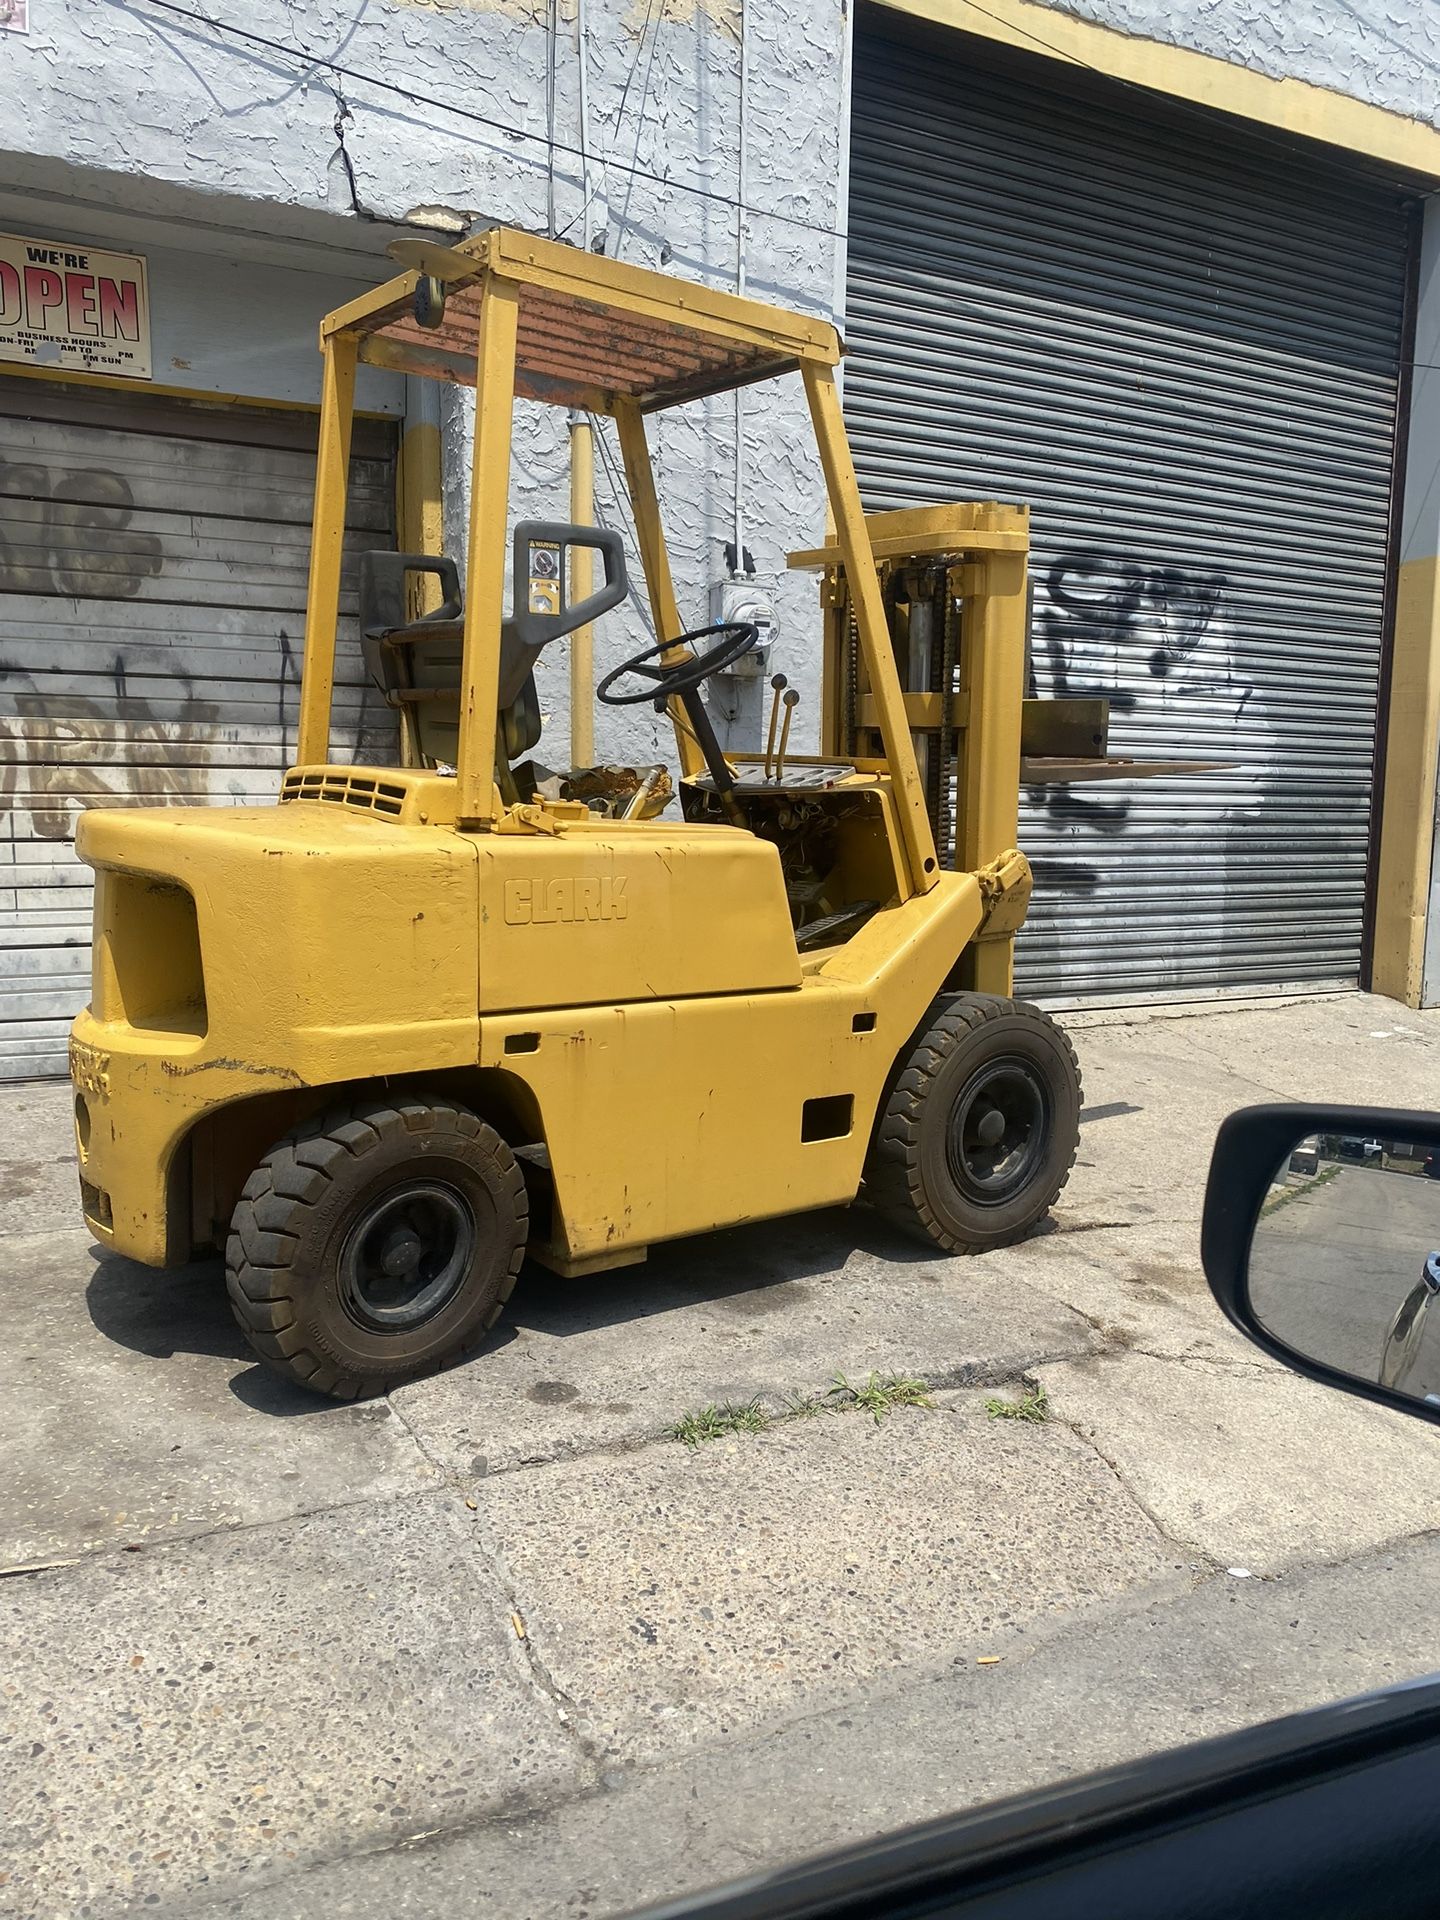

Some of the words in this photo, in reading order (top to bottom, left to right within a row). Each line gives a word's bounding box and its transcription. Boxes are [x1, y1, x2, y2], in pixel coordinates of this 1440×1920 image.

[26, 247, 89, 270] WE'RE
[17, 331, 69, 344] BUSINESS
[71, 338, 107, 348] HOURS
[60, 344, 77, 352] AM
[79, 346, 93, 354] TO
[118, 351, 134, 359] PM
[101, 356, 122, 365] SUN
[535, 541, 560, 550] WARNING
[504, 876, 628, 925] CLARK
